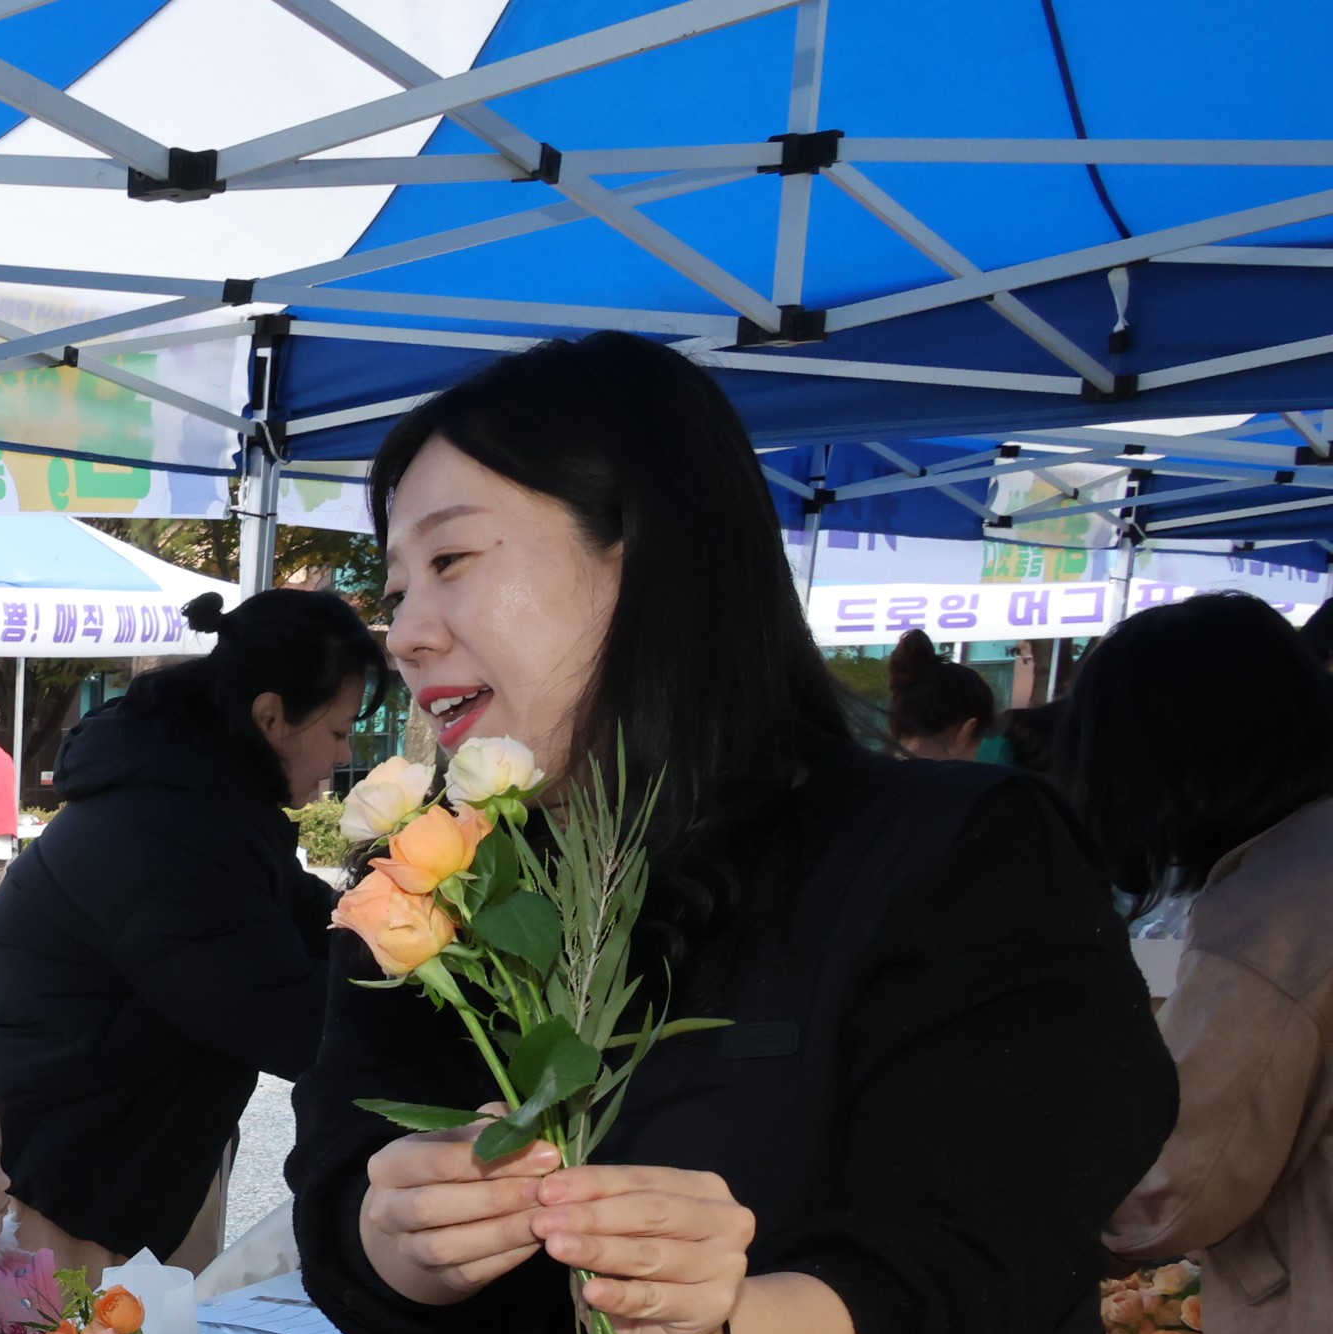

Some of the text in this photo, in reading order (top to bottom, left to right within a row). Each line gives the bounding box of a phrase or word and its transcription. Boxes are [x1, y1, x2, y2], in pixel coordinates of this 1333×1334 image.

[54, 606, 103, 643] 매직
[838, 597, 979, 634] 드로잉
[1010, 589, 1105, 626] 머그
